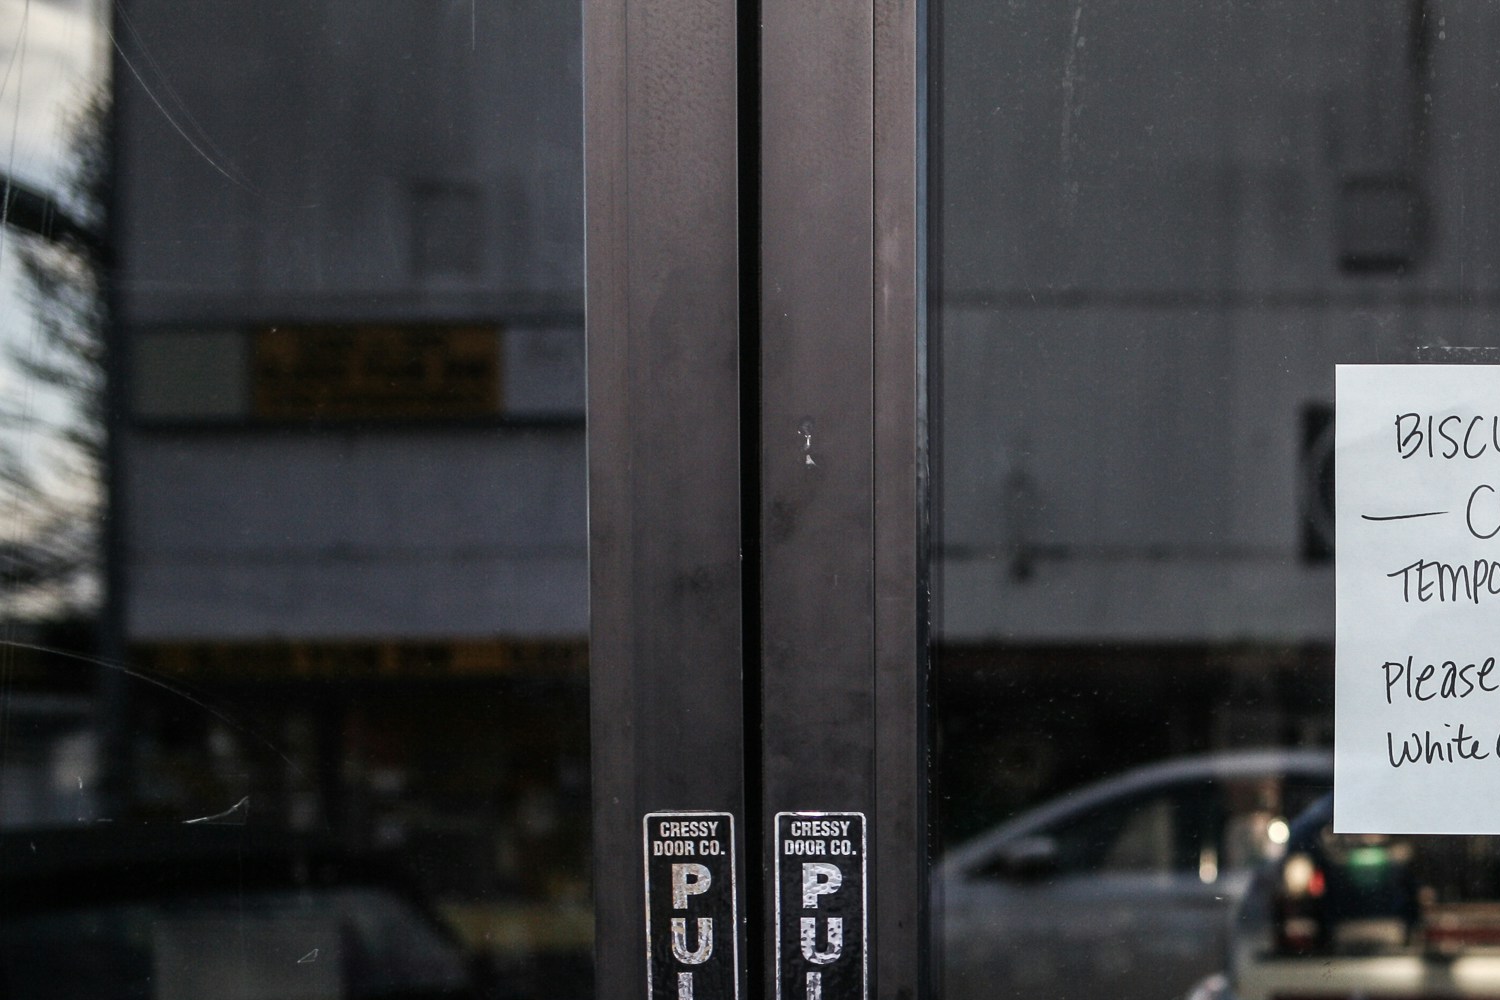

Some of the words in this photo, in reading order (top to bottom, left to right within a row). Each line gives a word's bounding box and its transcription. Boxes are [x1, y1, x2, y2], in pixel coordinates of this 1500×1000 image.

[1386, 722, 1490, 768] White
[659, 821, 719, 838] CRESSY
[791, 820, 851, 837] CRESSY
[653, 840, 696, 856] DOOR
[699, 839, 726, 856] CO.
[784, 839, 827, 856] DOOR
[830, 839, 857, 856] CO.
